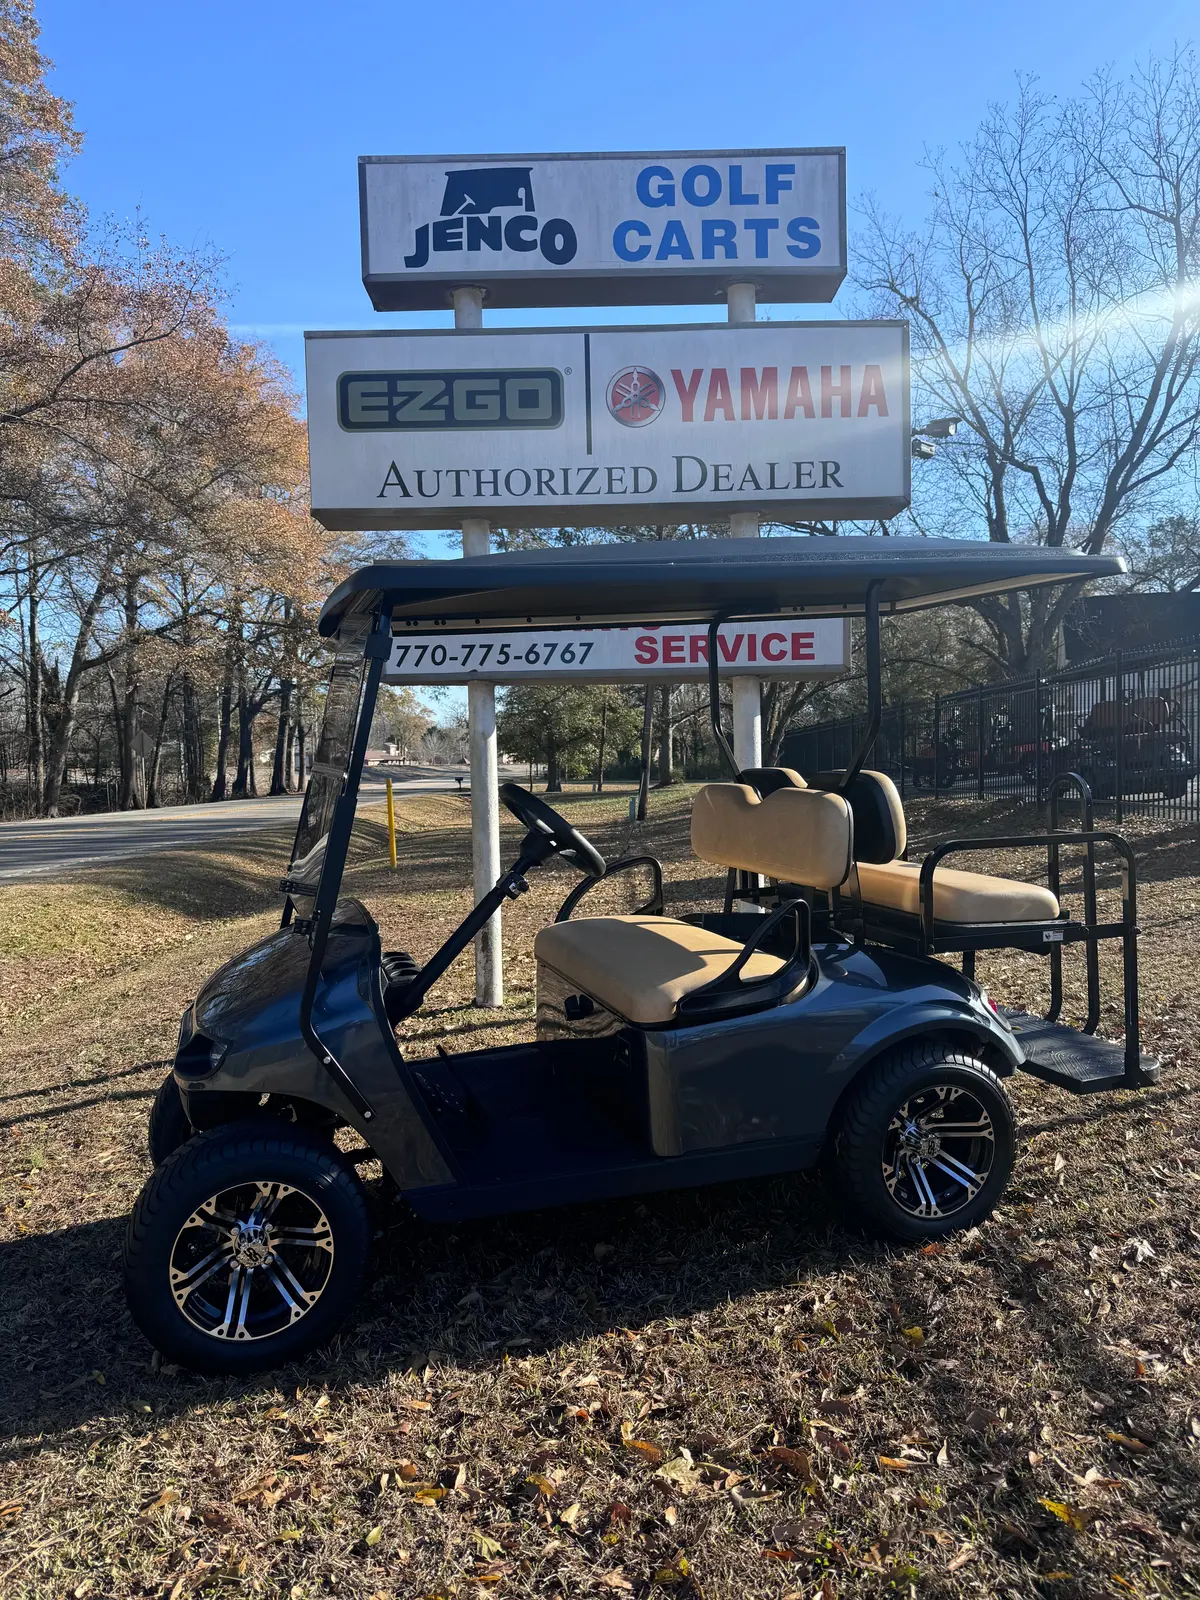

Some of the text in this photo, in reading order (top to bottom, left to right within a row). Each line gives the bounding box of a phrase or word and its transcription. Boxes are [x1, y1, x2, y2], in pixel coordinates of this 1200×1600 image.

[635, 164, 795, 208] GOLF
[404, 214, 577, 268] JENCO
[612, 217, 822, 262] CARTS
[346, 378, 554, 423] EZGO
[670, 364, 889, 423] YAMAHA
[396, 642, 594, 668] 770-775-6767
[634, 632, 815, 665] SERVICE
